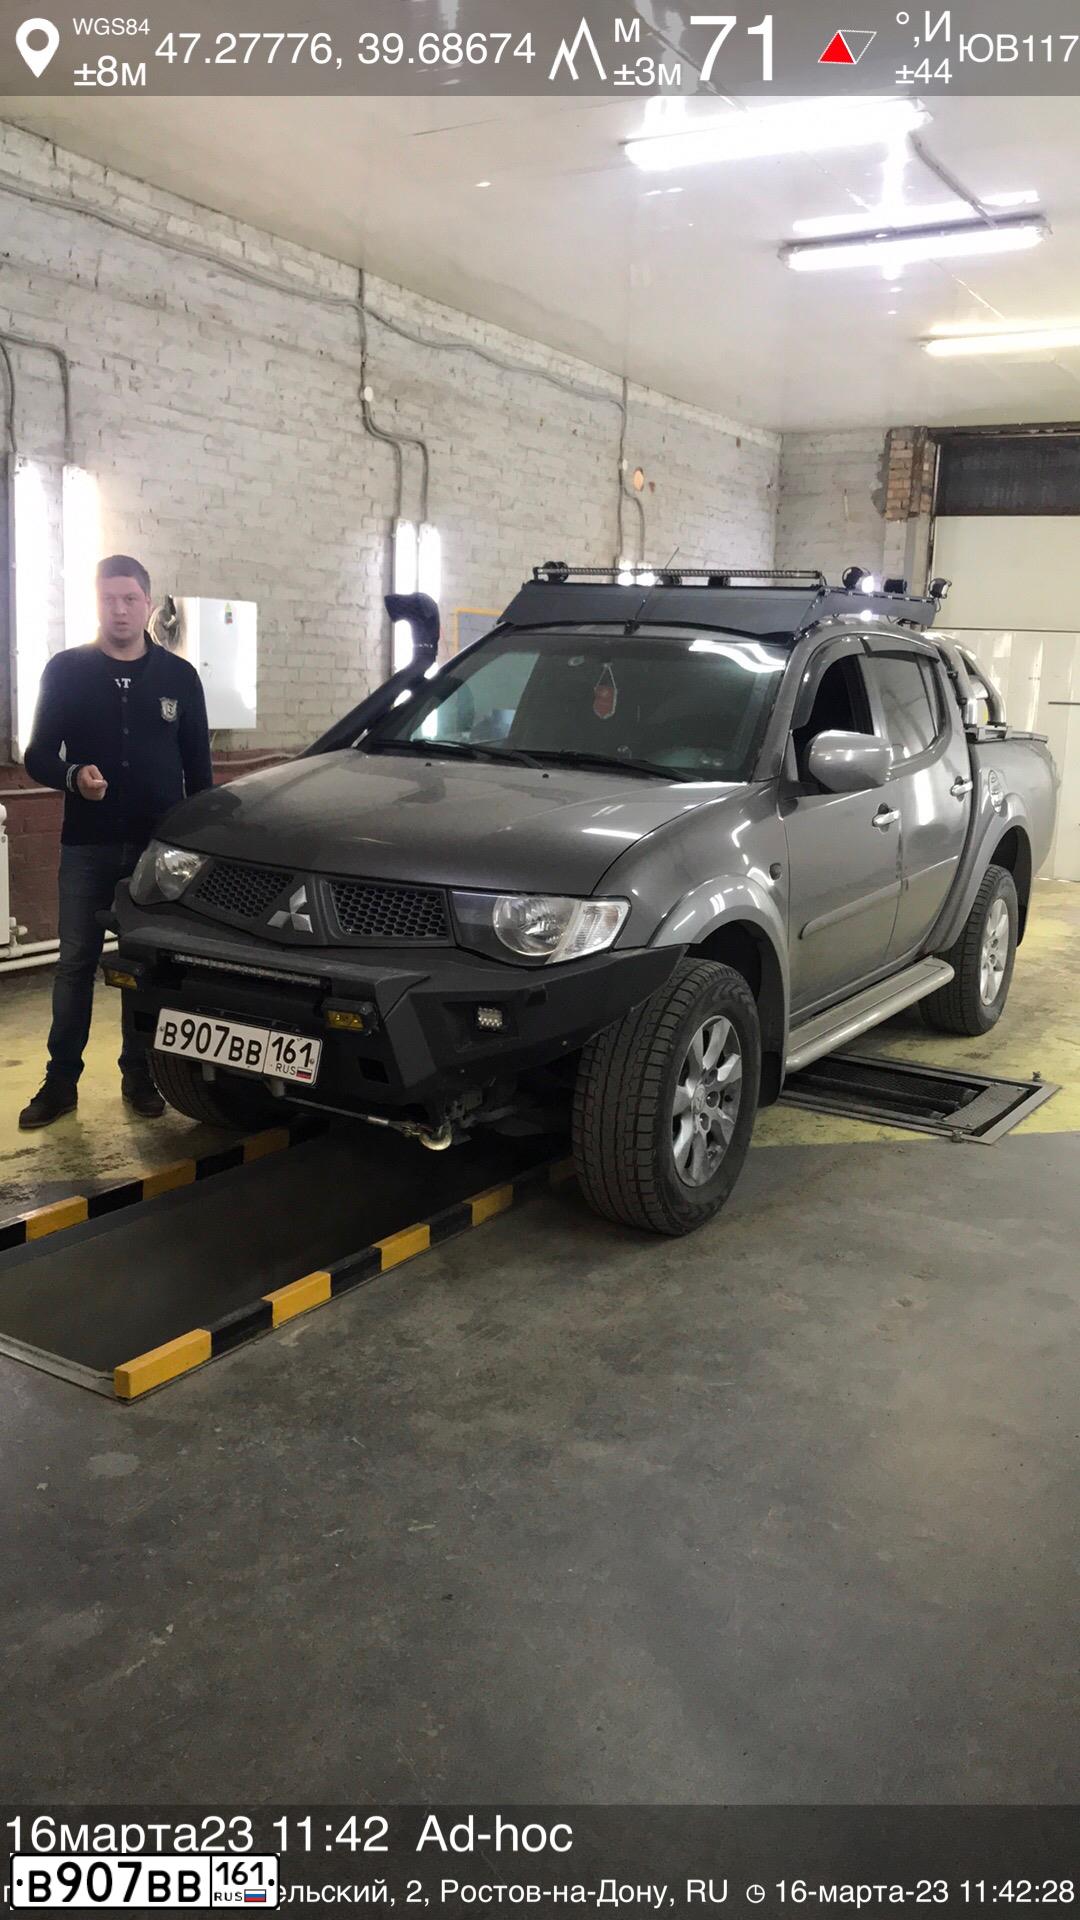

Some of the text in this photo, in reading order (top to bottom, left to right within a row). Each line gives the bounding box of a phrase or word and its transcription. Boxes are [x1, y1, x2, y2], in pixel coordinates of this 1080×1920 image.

[161, 1018, 313, 1068] В907ВВ 161
[275, 1062, 297, 1076] RUS
